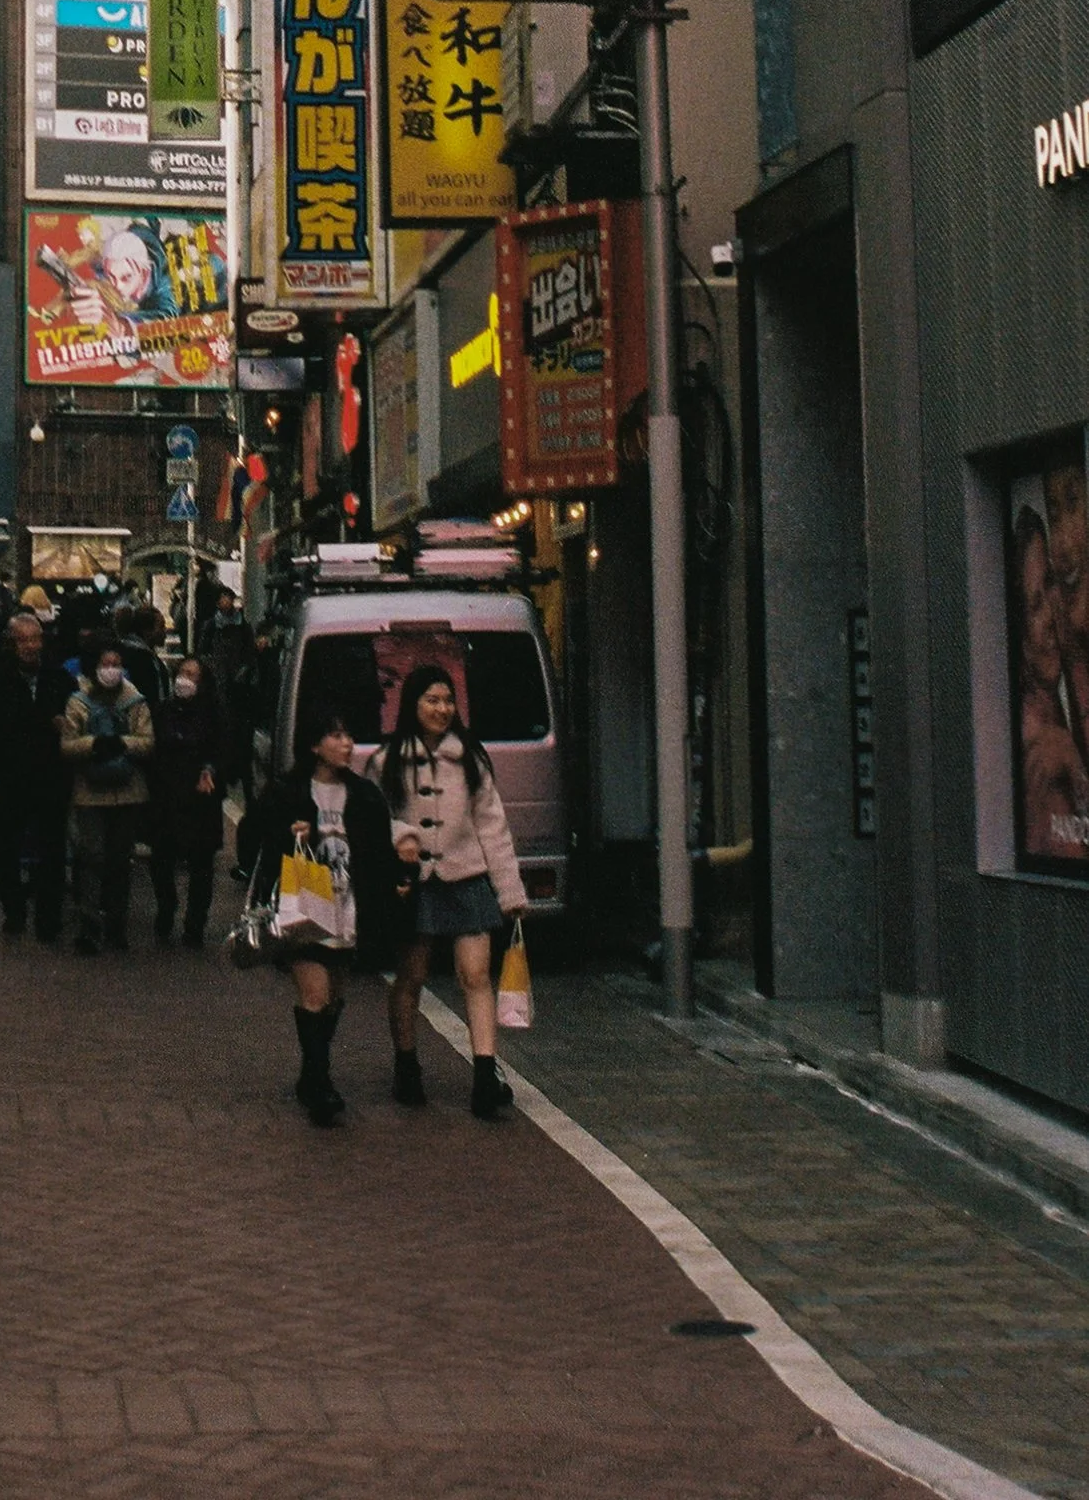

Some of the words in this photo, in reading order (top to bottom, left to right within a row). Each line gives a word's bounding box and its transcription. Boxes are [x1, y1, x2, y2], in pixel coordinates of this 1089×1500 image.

[397, 3, 438, 142] 食べ放題
[440, 7, 503, 136] 和牛
[398, 191, 416, 206] all
[421, 194, 450, 209] you
[455, 195, 484, 206] can
[426, 173, 485, 189] WAGYU
